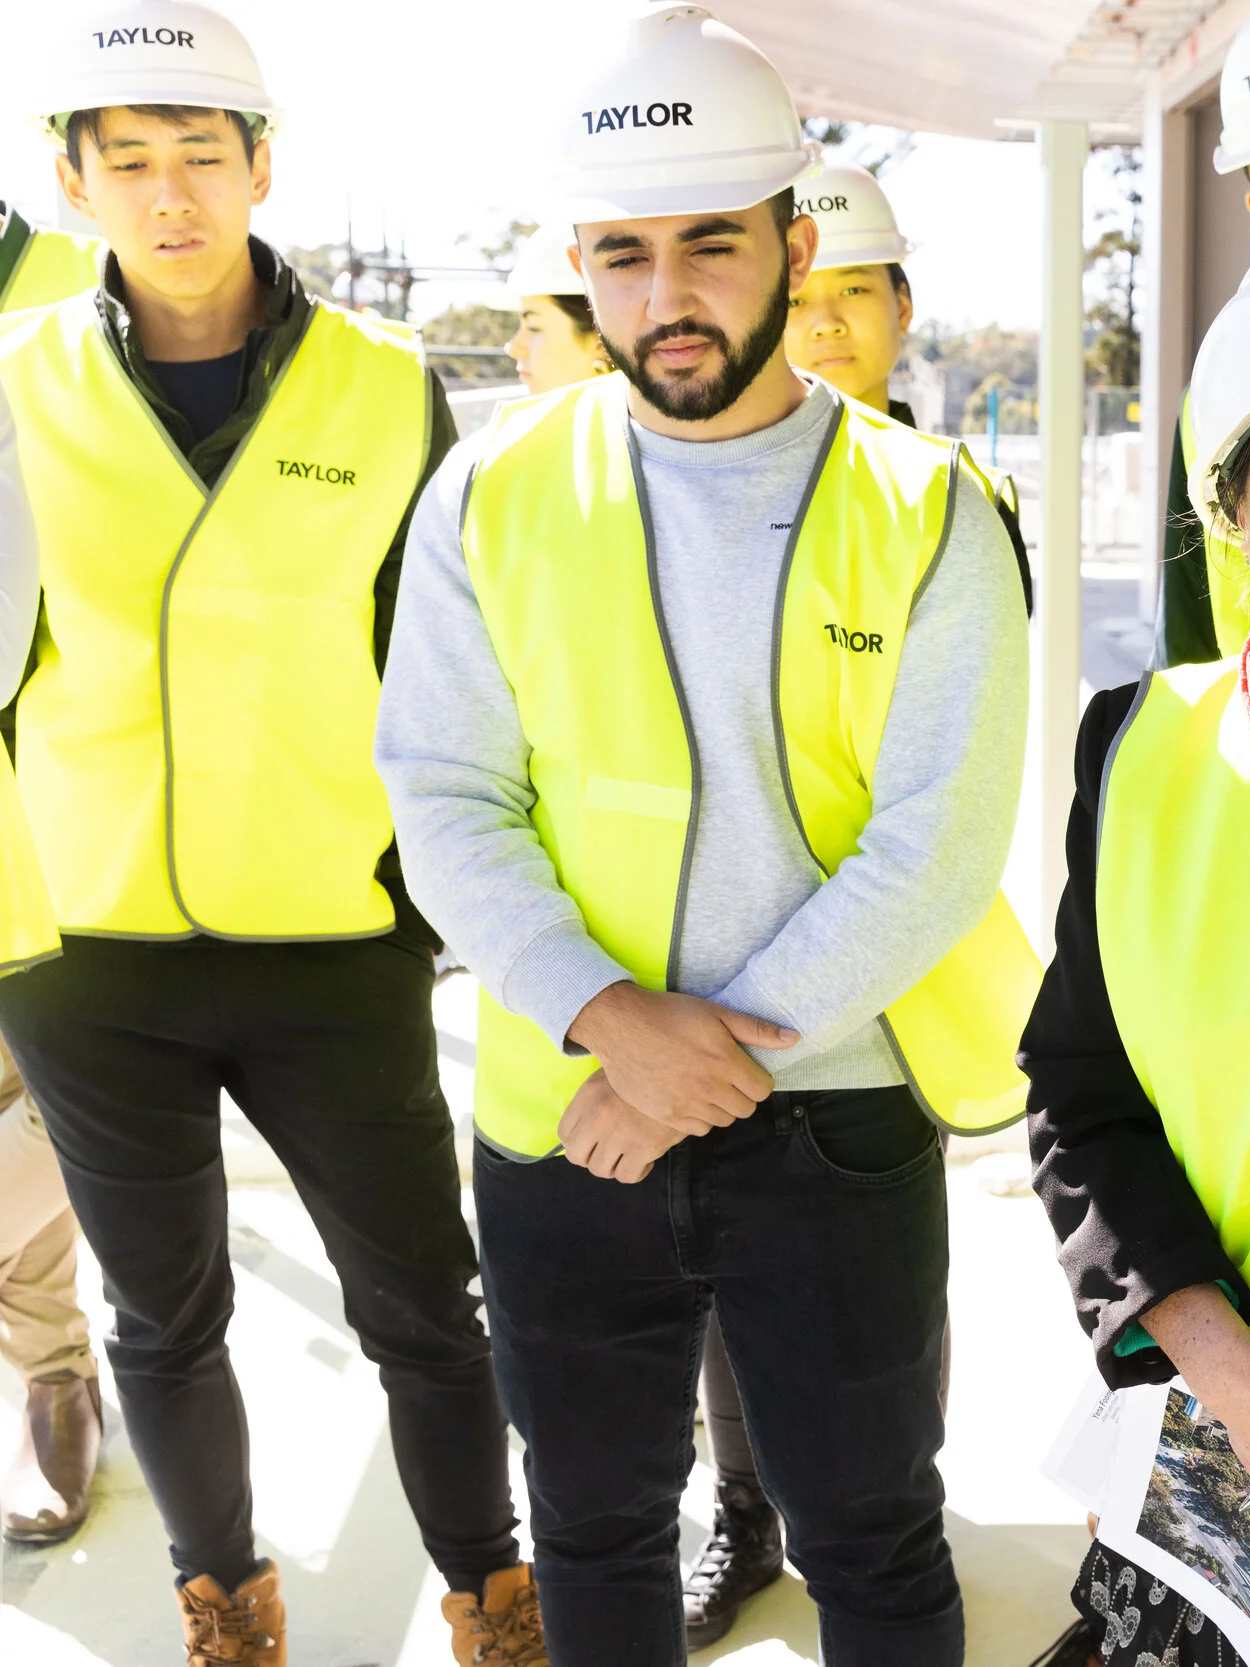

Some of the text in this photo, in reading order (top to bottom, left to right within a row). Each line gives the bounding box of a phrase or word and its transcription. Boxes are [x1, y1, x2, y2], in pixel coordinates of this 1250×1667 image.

[92, 27, 196, 50] TAYLOR
[581, 102, 694, 135] TAYLOR
[793, 196, 849, 216] YLOR
[275, 459, 357, 486] TAYLOR
[823, 623, 884, 655] TYOR
